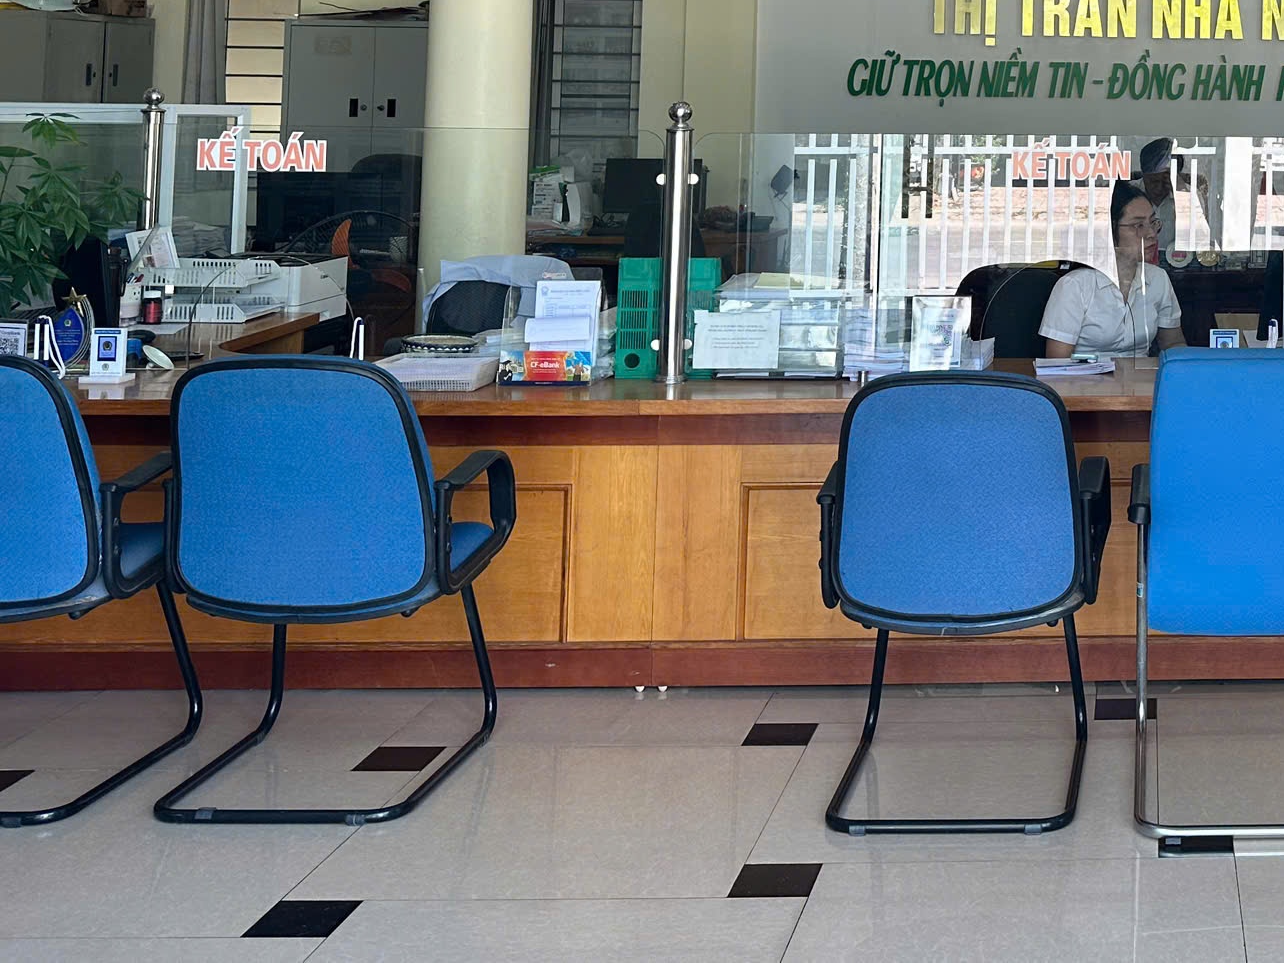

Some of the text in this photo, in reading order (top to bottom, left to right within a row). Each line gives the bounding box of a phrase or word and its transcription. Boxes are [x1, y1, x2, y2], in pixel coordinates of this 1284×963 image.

[847, 50, 901, 96] GIỮ
[902, 59, 974, 107] TRỌN
[976, 47, 1039, 98] NIỀM
[1048, 62, 1088, 99] TIN
[1106, 49, 1186, 100] ĐỒNG
[1190, 55, 1266, 101] HÀNH
[196, 126, 327, 172] KẾ TOÁN
[1011, 137, 1132, 180] KẾ TOÁN
